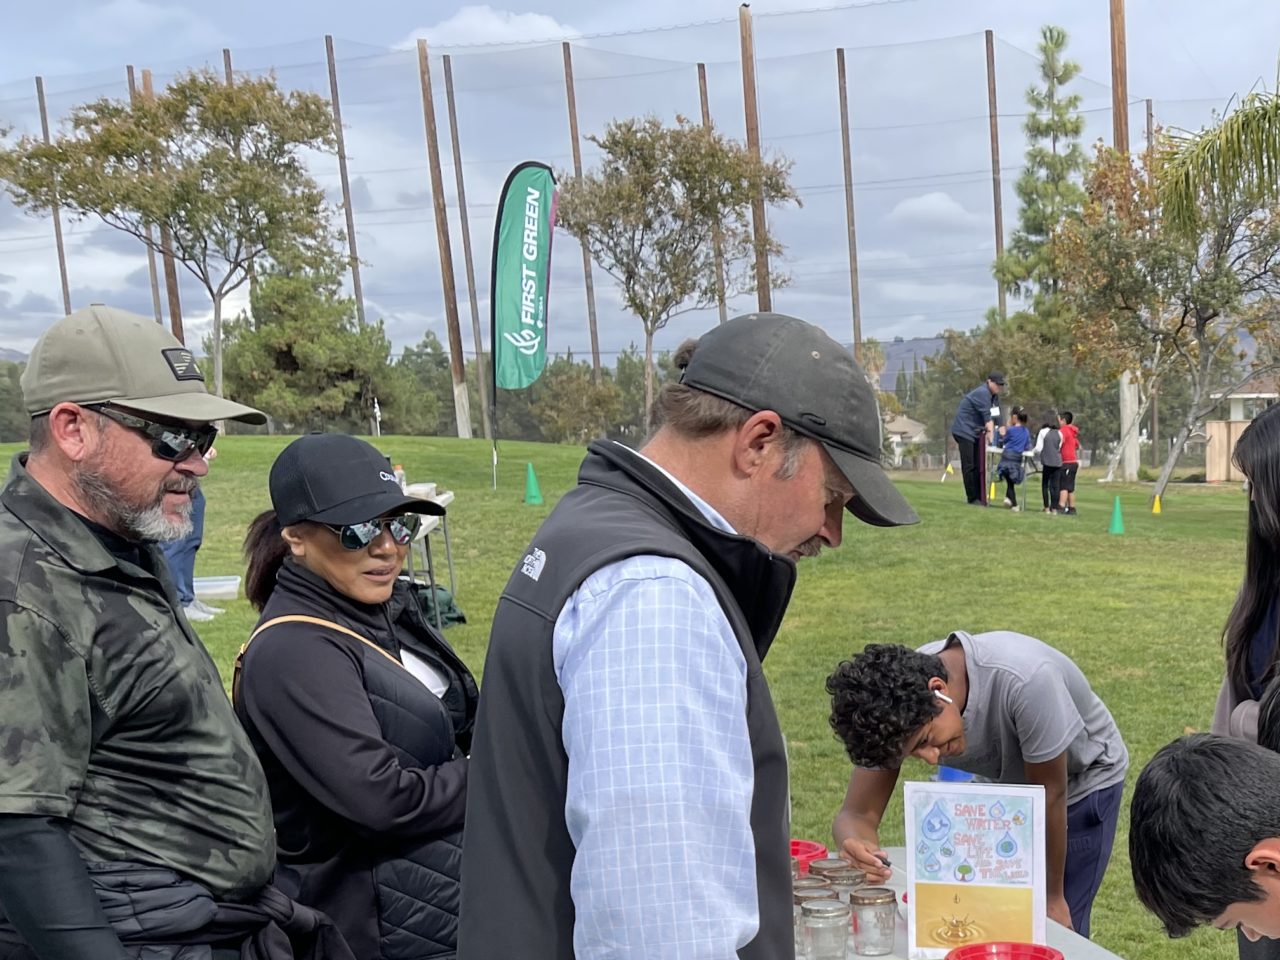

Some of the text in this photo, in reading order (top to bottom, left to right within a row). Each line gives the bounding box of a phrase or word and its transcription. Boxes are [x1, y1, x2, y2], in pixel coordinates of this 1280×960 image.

[521, 187, 541, 325] FIRST GREEN
[954, 803, 986, 817] SAVE
[965, 817, 1012, 831] WATER
[953, 832, 985, 847] SAVE
